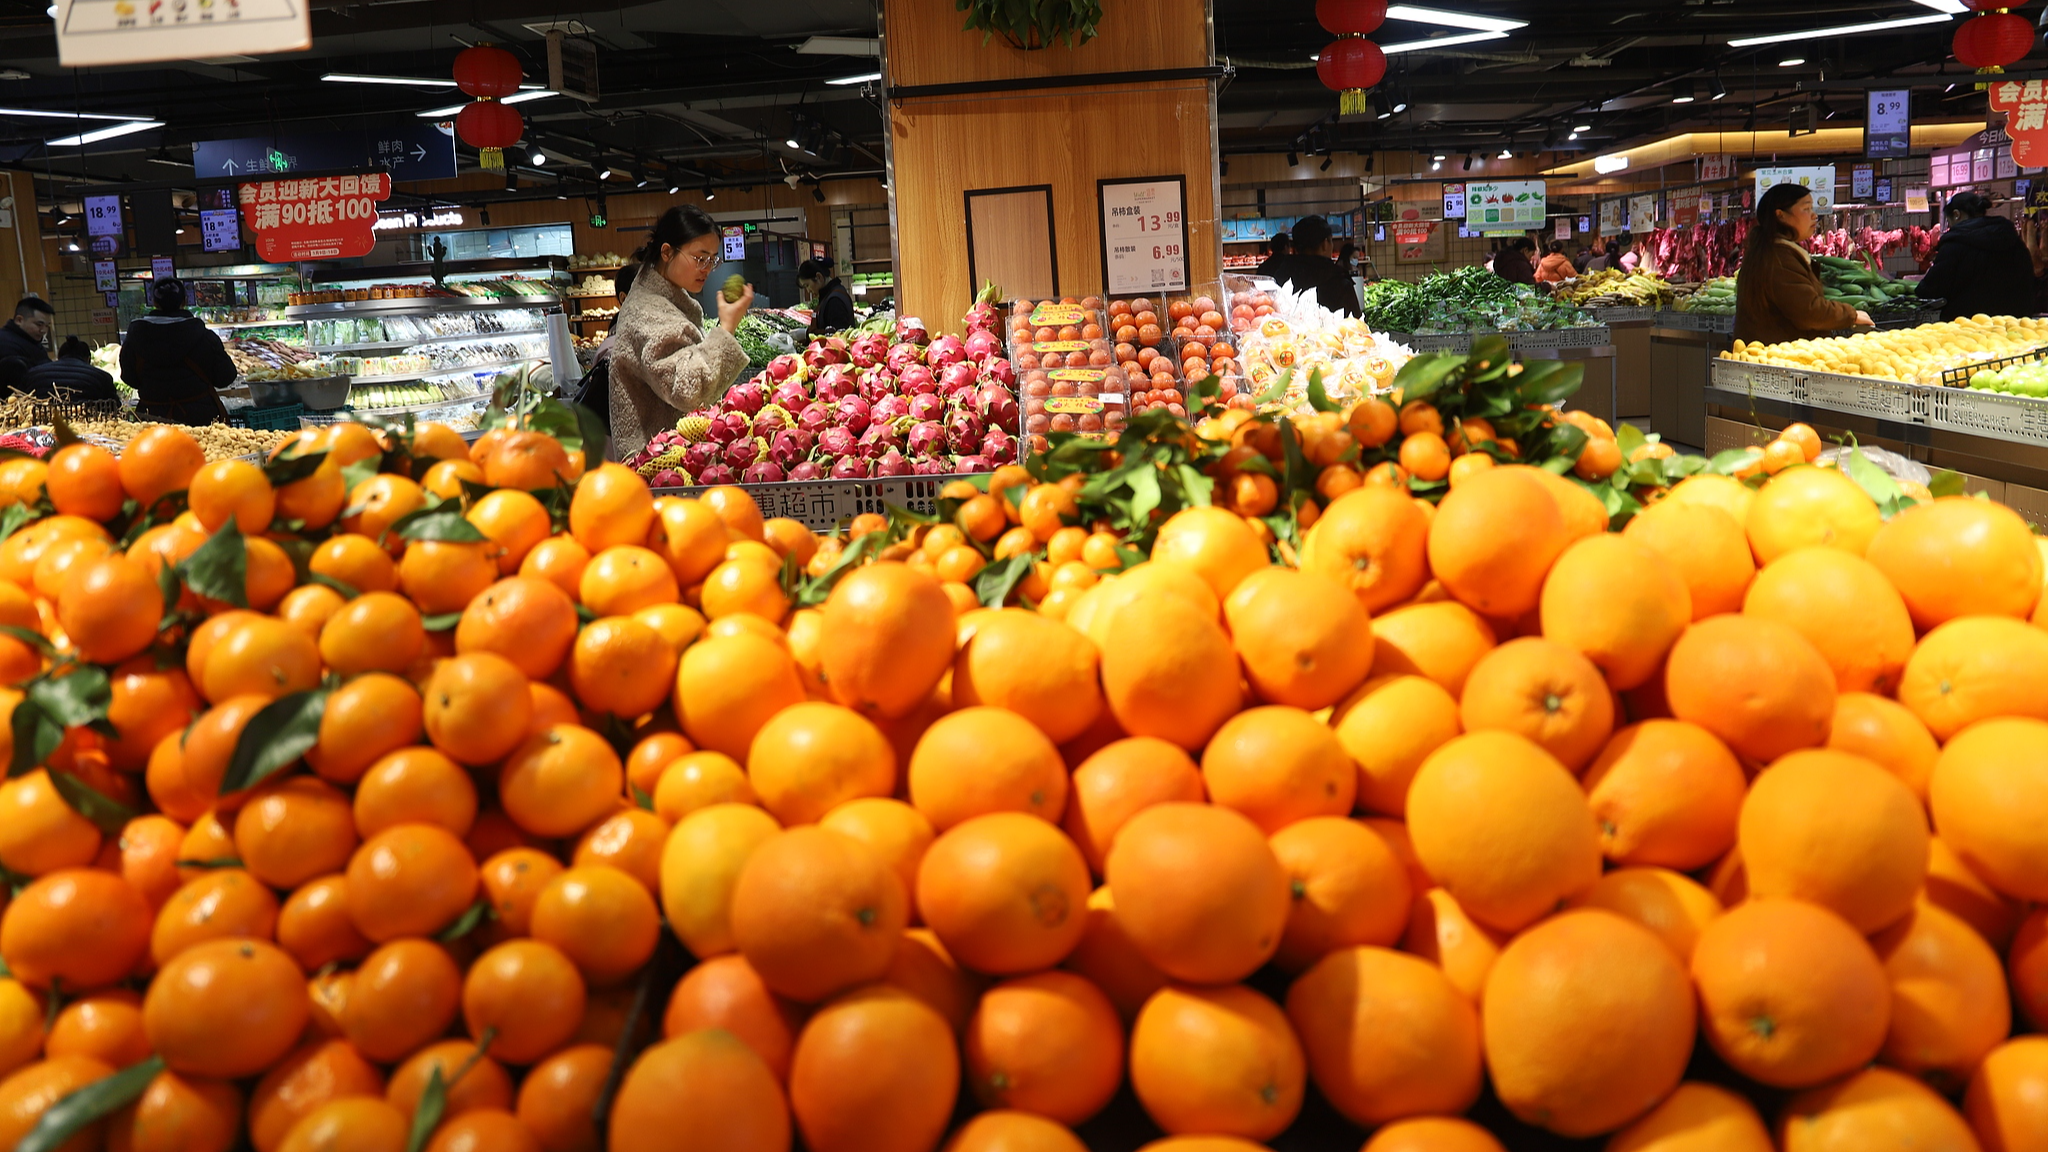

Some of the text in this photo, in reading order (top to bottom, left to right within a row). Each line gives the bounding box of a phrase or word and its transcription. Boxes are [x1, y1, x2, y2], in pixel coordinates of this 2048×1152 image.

[1998, 81, 2048, 103] 会员
[1877, 102, 1901, 115] 8.99
[1979, 129, 2011, 144] 今日价
[377, 139, 404, 154] 鲜肉
[245, 155, 298, 172] 生鲜界
[379, 155, 405, 169] 水产
[1952, 164, 1968, 176] 16.99
[1977, 165, 1988, 178] 10
[238, 173, 381, 204] 会员迎新大回馈
[90, 206, 116, 218] 18.99
[254, 197, 372, 229] 满90抵100
[1112, 205, 1140, 217] 吊柿盒装
[1137, 211, 1180, 232] 13.99
[1152, 244, 1179, 259] 6.99
[1559, 331, 1602, 344] 佳惠超市
[1954, 398, 1979, 411] JIAHUI
[1953, 408, 2011, 429] SUPERMARKET
[752, 490, 835, 519] 惠超市
